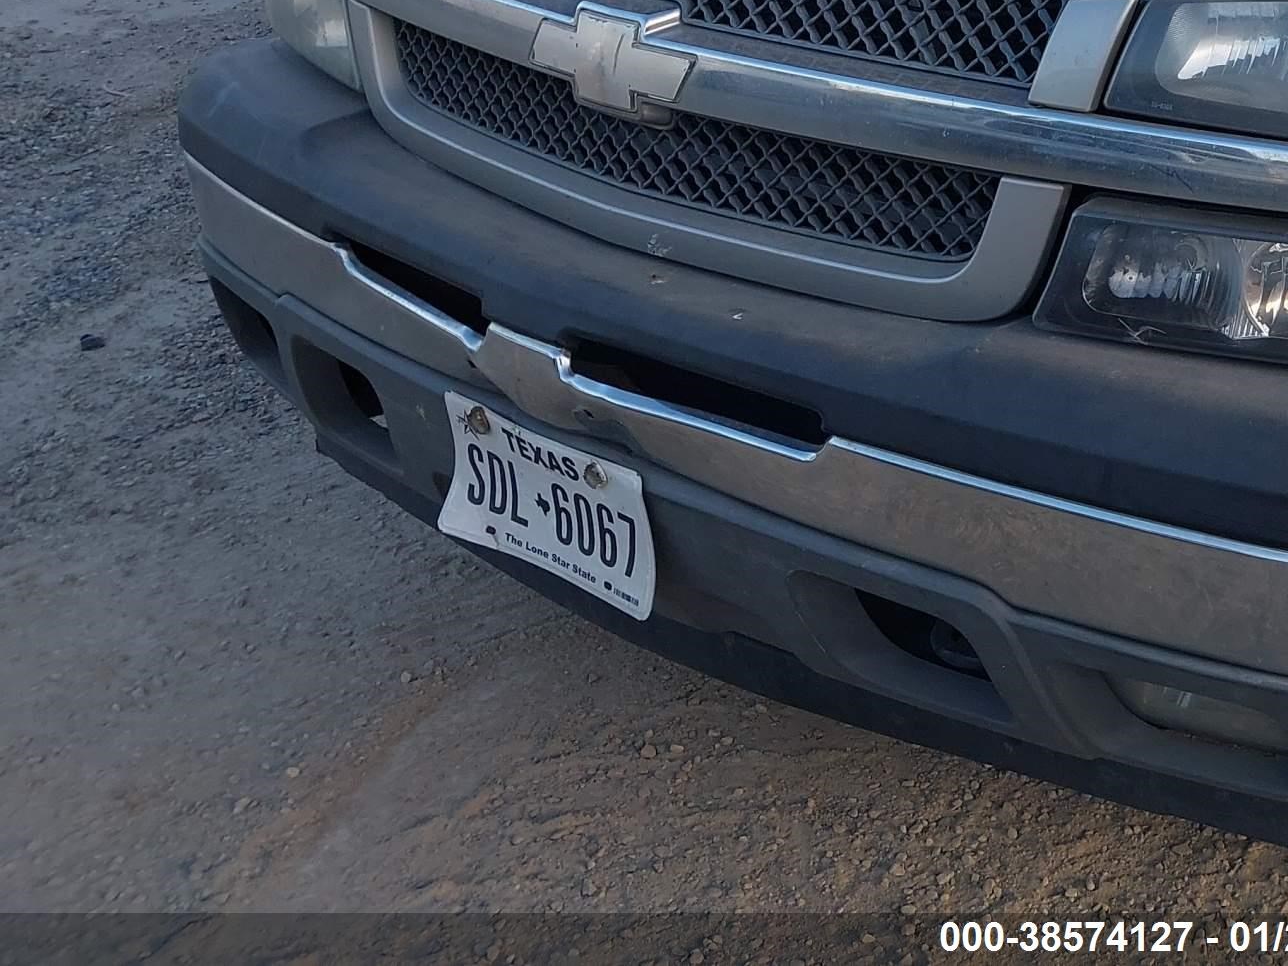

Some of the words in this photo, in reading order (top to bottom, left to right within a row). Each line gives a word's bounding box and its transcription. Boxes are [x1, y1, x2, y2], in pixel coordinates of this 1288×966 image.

[501, 427, 579, 481] TEXAS
[467, 443, 529, 528] SDL
[551, 483, 636, 578] 6067
[505, 532, 523, 547] The
[526, 541, 549, 559] Lone
[551, 554, 570, 570] Star
[572, 564, 596, 583] State
